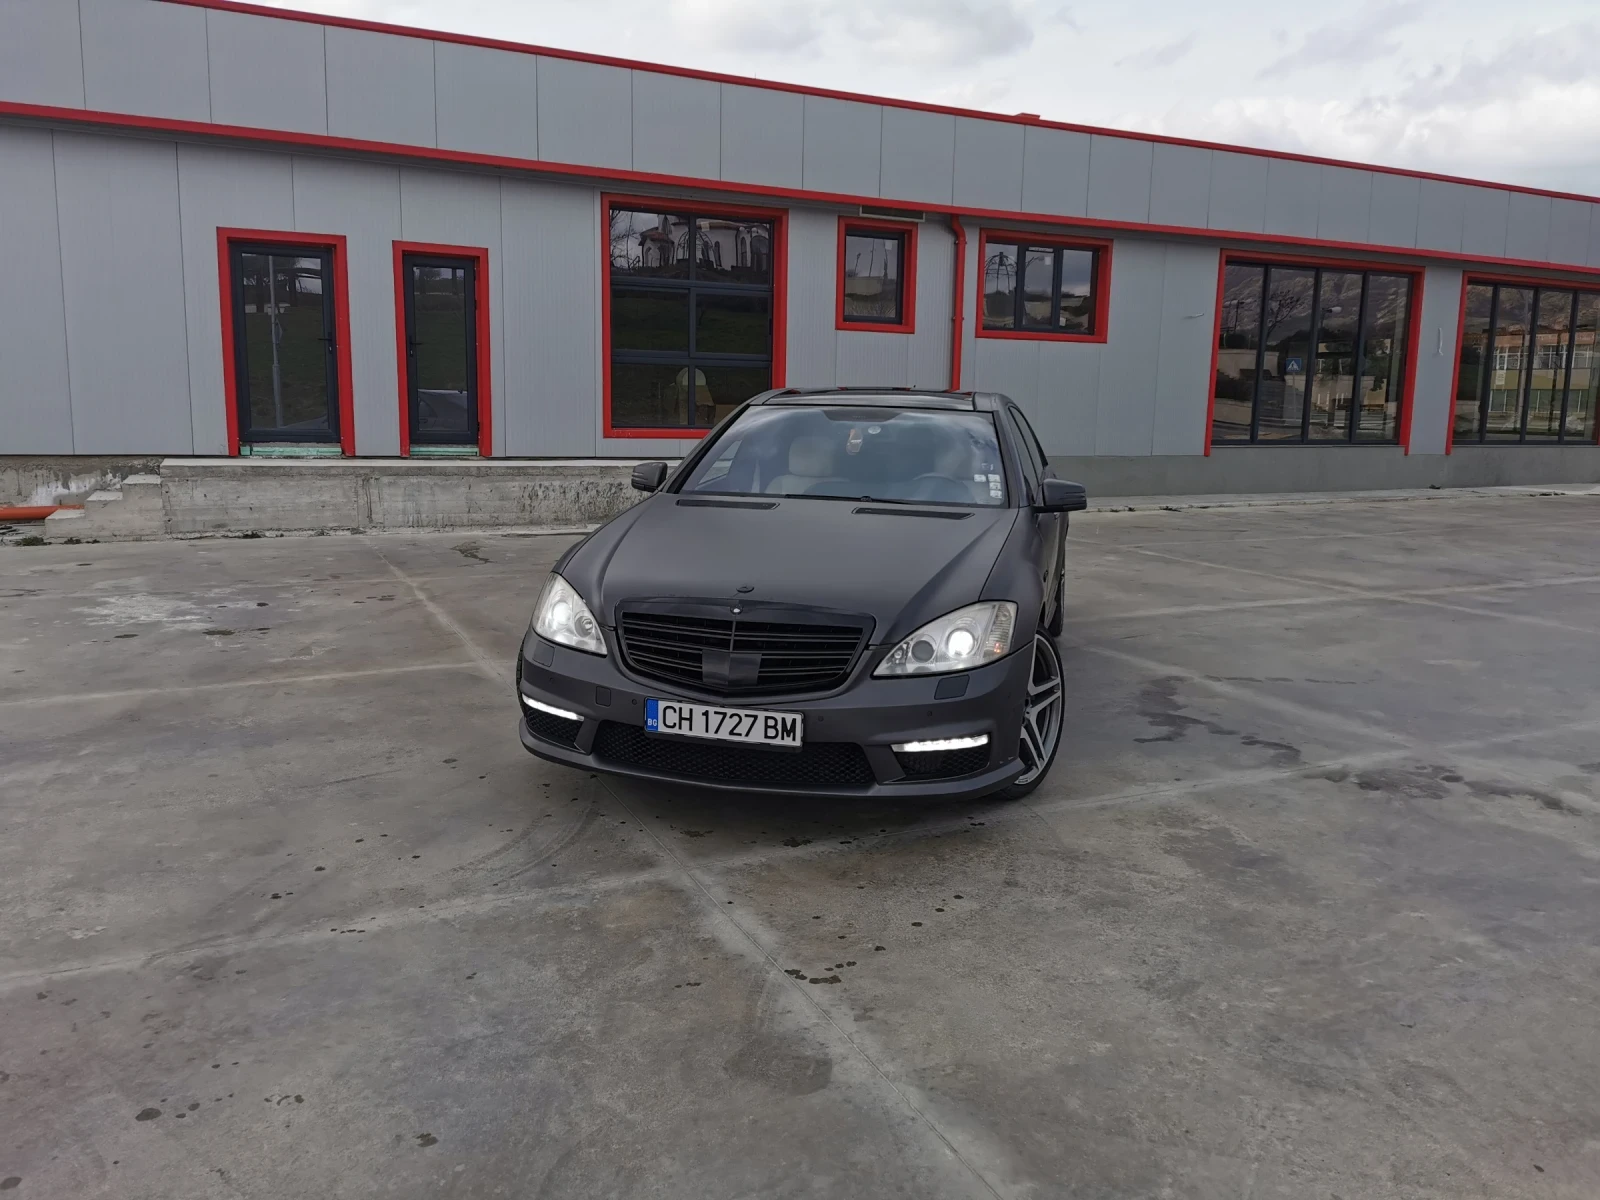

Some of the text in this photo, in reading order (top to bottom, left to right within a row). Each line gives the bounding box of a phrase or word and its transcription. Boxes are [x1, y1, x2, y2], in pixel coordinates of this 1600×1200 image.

[647, 718, 658, 727] BG
[662, 705, 797, 742] CH 1727 BM
